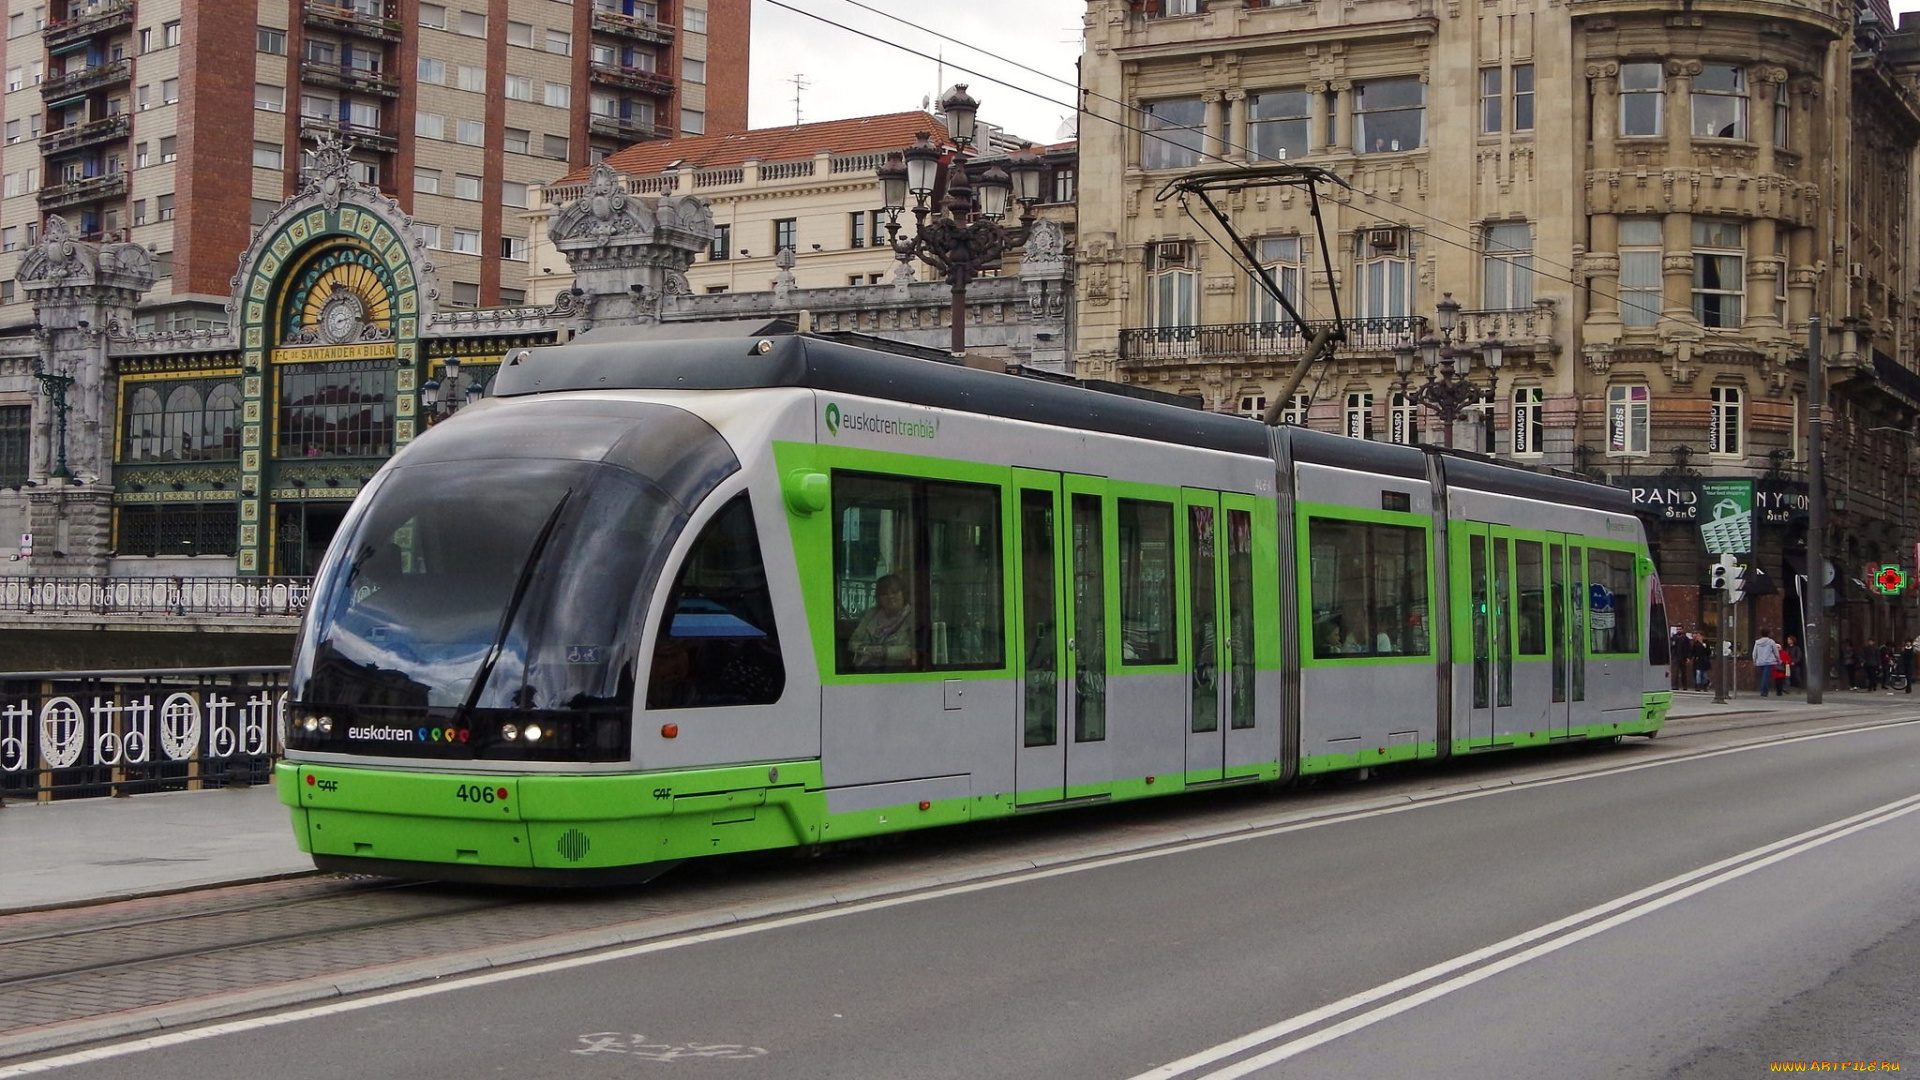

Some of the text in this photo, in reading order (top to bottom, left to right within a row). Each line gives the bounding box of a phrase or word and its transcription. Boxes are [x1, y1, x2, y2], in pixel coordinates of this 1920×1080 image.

[301, 347, 355, 359] SANTANDER
[1517, 409, 1525, 450] GIMNASIO
[1613, 408, 1624, 446] fitness
[349, 725, 413, 741] euskotren
[317, 780, 338, 792] CAF
[456, 784, 495, 803] 406
[653, 788, 672, 800] CAF
